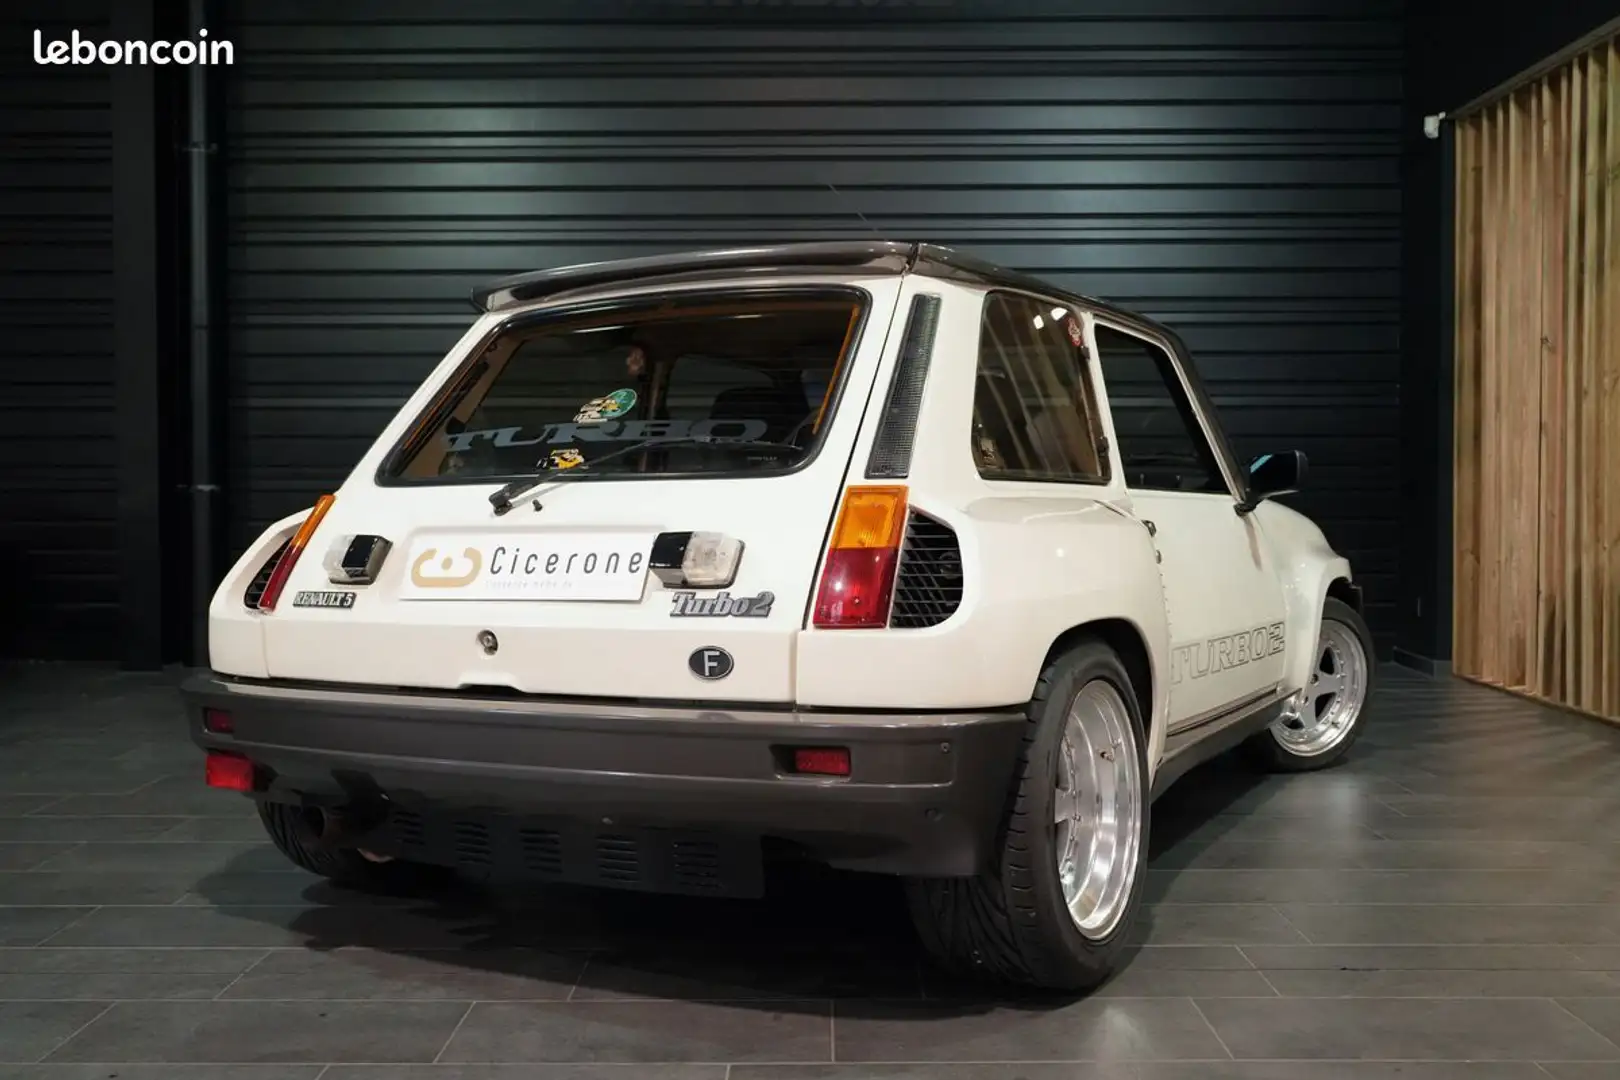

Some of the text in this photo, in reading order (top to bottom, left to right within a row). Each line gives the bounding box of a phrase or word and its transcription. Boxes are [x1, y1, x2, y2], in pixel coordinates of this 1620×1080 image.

[445, 419, 768, 450] TURBO
[489, 546, 643, 576] Cicerone
[293, 591, 345, 606] RENAULT
[703, 650, 721, 677] F
